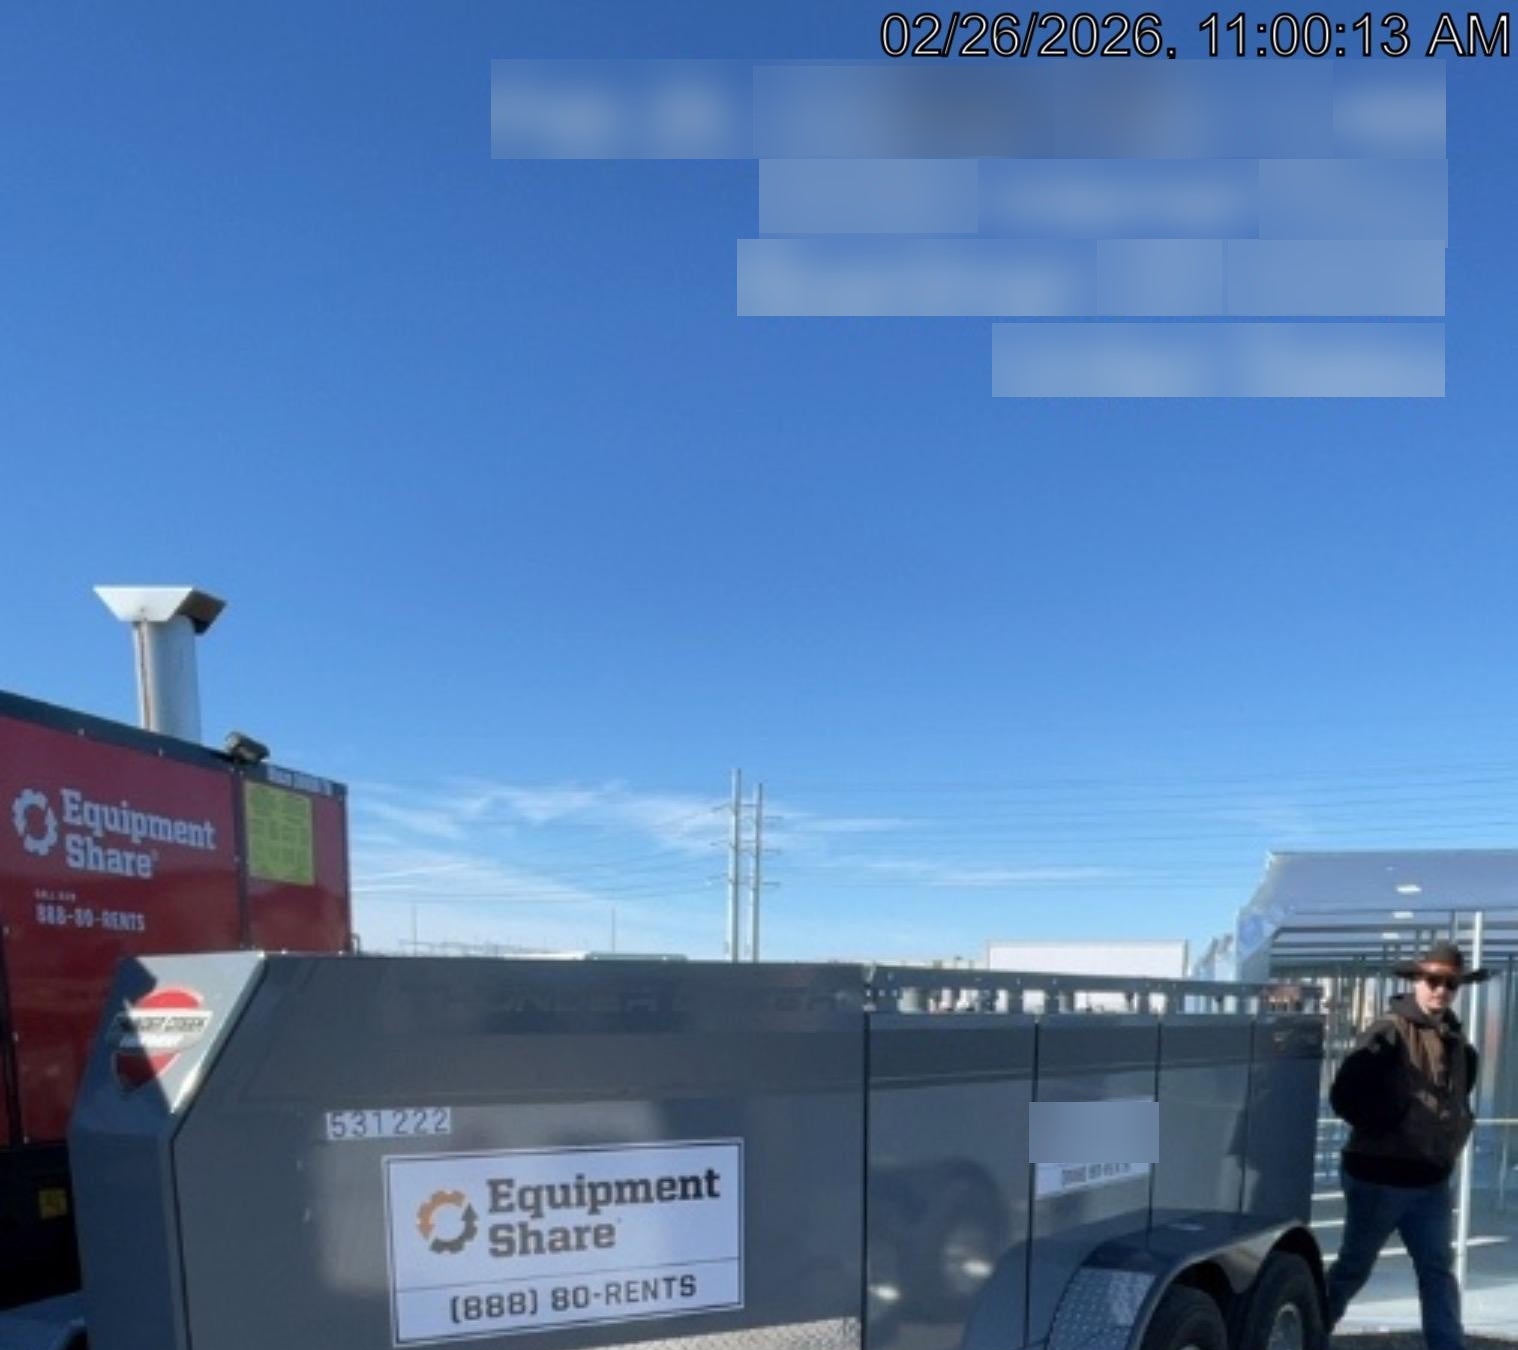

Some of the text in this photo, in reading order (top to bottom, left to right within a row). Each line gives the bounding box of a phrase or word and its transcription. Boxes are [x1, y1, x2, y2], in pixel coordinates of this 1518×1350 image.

[61, 788, 215, 849] Equipment
[66, 834, 152, 878] Share
[331, 1109, 449, 1137] 531222
[486, 1168, 720, 1219] Equipment
[487, 1221, 616, 1257] Share
[450, 1274, 697, 1323] (888) 80-RENTS
